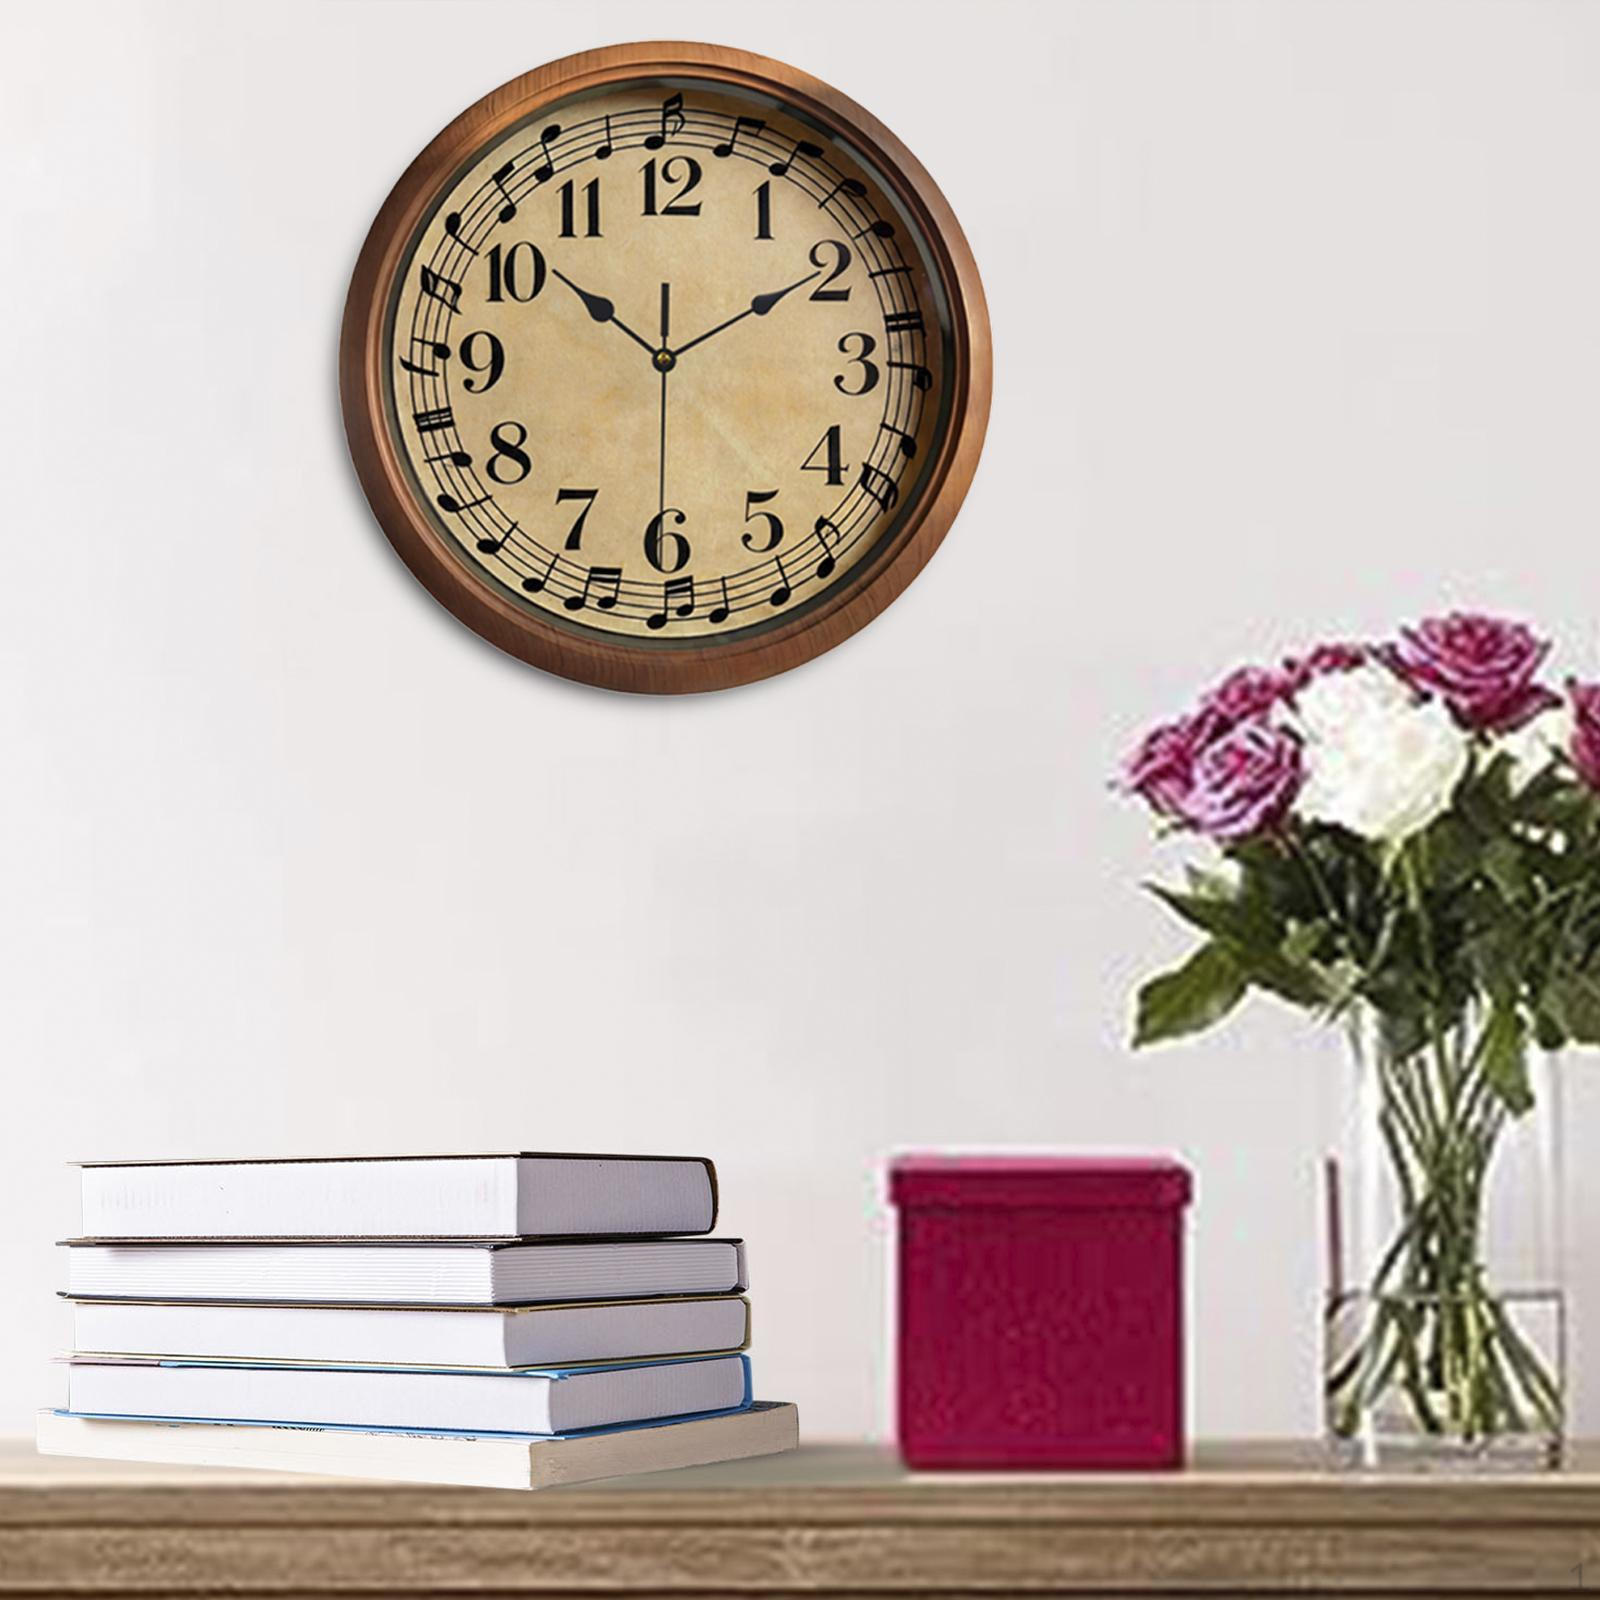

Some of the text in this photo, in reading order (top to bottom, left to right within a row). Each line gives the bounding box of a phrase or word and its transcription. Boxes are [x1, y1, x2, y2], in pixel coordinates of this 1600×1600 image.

[556, 178, 603, 238] 11
[640, 156, 703, 216] 12
[753, 180, 774, 240] 1
[485, 241, 546, 303] 10
[808, 240, 853, 301] 2
[459, 331, 505, 393] 9
[833, 332, 879, 396] 3
[486, 422, 532, 484] 8
[801, 425, 848, 486] 4
[555, 488, 598, 550] 7
[644, 508, 690, 573] 6
[741, 490, 784, 552] 5
